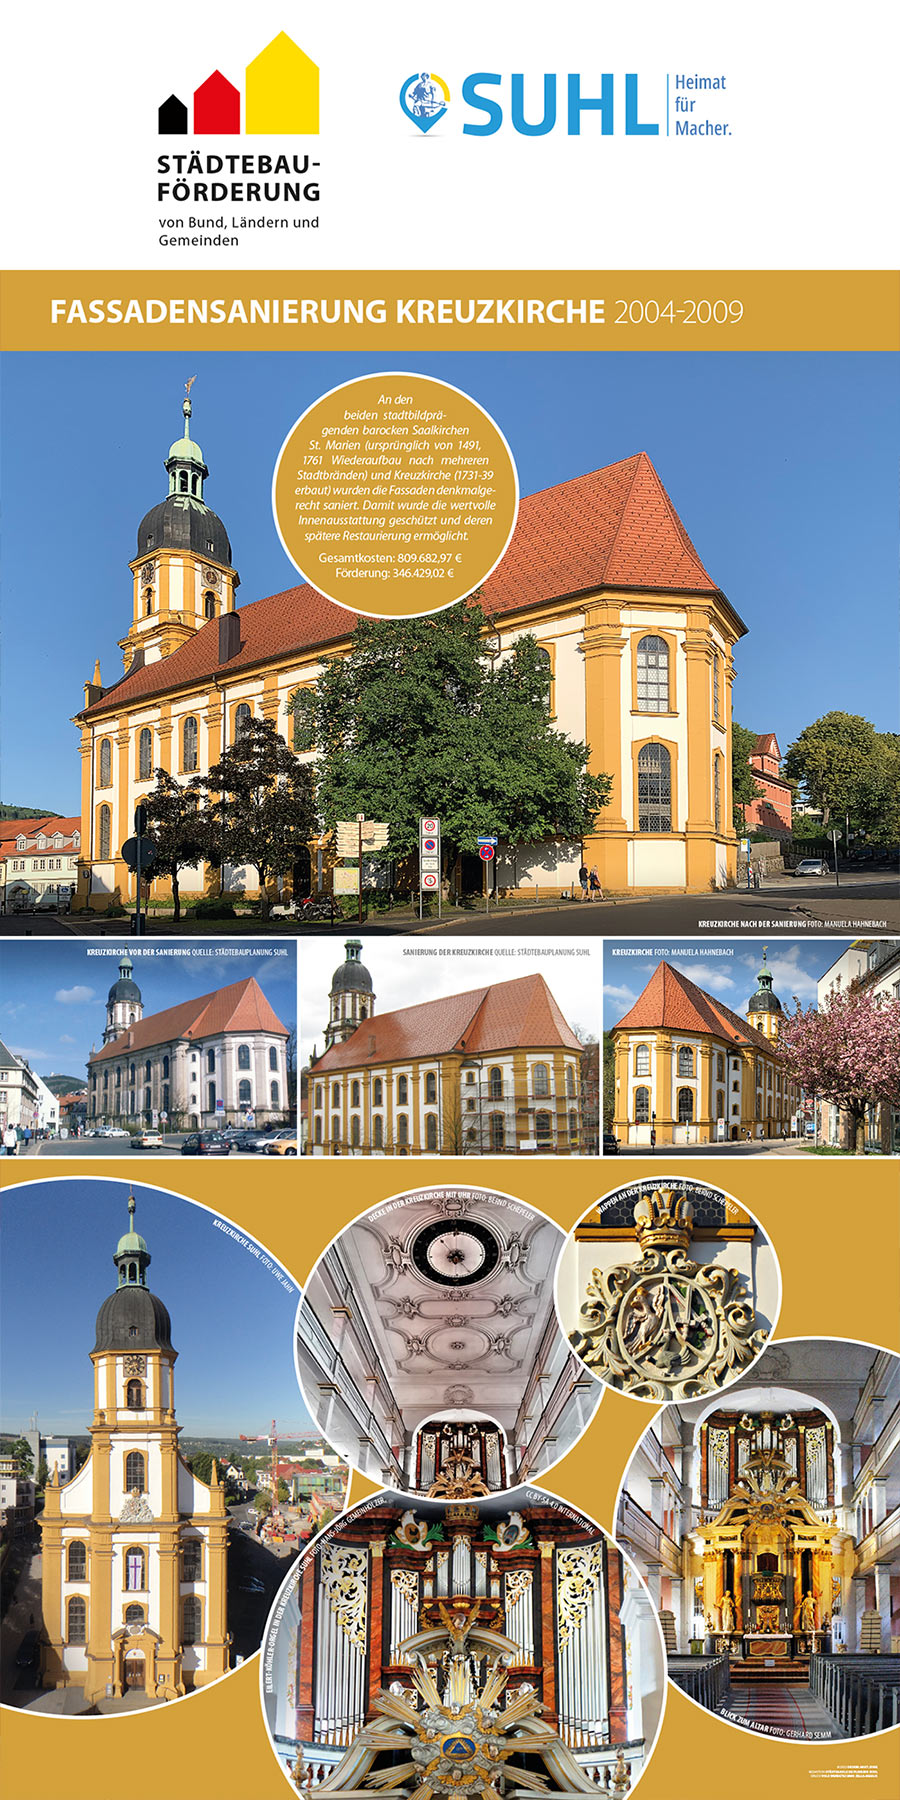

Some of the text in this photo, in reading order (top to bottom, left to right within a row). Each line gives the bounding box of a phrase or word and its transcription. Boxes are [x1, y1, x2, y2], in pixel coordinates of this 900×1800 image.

[676, 74, 725, 89] Heimat
[462, 73, 659, 136] SUHL
[675, 97, 695, 112] für
[676, 120, 731, 135] Macher.
[158, 152, 320, 174] STÄDTEBAU-
[158, 178, 319, 201] FÖRDERUNG
[159, 216, 318, 229] von Bund, Ländern und
[159, 234, 238, 246] Gemeinden
[52, 300, 743, 323] FASSADENSANIERUNG KREUZKIRCHE 2004-2009
[378, 395, 413, 404] An den
[344, 410, 446, 422] beiden stadtbildprä-
[322, 425, 469, 437] genden barocken Saalkirchen
[309, 440, 480, 452] St. Marien (ursprünglich von 1491,
[304, 455, 489, 465] 1761 Wiederaufbau nach mehreren
[297, 470, 494, 480] Stadtbränden) und Kreuzkirche (1731-39
[295, 485, 496, 497] erbaut) wurden die Fassaden denkmalge-
[296, 500, 496, 510] recht saniert. Damit wurde die wertvolle
[299, 515, 492, 527] Innenausstattung geschützt und deren
[305, 531, 468, 543] spätere Restaurierung ermöglicht.
[319, 553, 462, 563] Gesamtkosten: 809.682,97 €
[336, 568, 454, 580] Förderung: 346.429,02 €
[698, 920, 886, 928] KREUZKIRCHE NACH DER SANIERUNG FOTO: MANUELA HAHNEBACH
[192, 949, 214, 957] QUELLE:
[215, 947, 273, 956] STÄDTEBAUPLANUNG
[494, 949, 516, 957] QUELLE:
[518, 947, 575, 956] STÄDTEBAUPLANUNG
[596, 1196, 618, 1214] WAPPEN
[618, 1192, 627, 1201] AN
[626, 1188, 638, 1197] DER
[368, 1208, 386, 1223] DECKE
[386, 1205, 393, 1213] IN
[392, 1200, 406, 1209] DER
[405, 1192, 444, 1206] KREUZKIRCHE
[212, 1219, 294, 1293] KREUZKIRCHE SUHL FOTO: UWE JAHN
[558, 1506, 596, 1535] INTERNATIONAL
[302, 1556, 312, 1570] SUHL
[281, 1569, 303, 1607] KREUZKIRCHE
[276, 1607, 284, 1620] DER
[274, 1620, 280, 1628] IN
[720, 1708, 737, 1720] BLICK
[736, 1716, 750, 1726] ZUM
[750, 1721, 770, 1732] ALTAR
[769, 1726, 786, 1736] FOTO:
[786, 1730, 813, 1739] GERHARD
